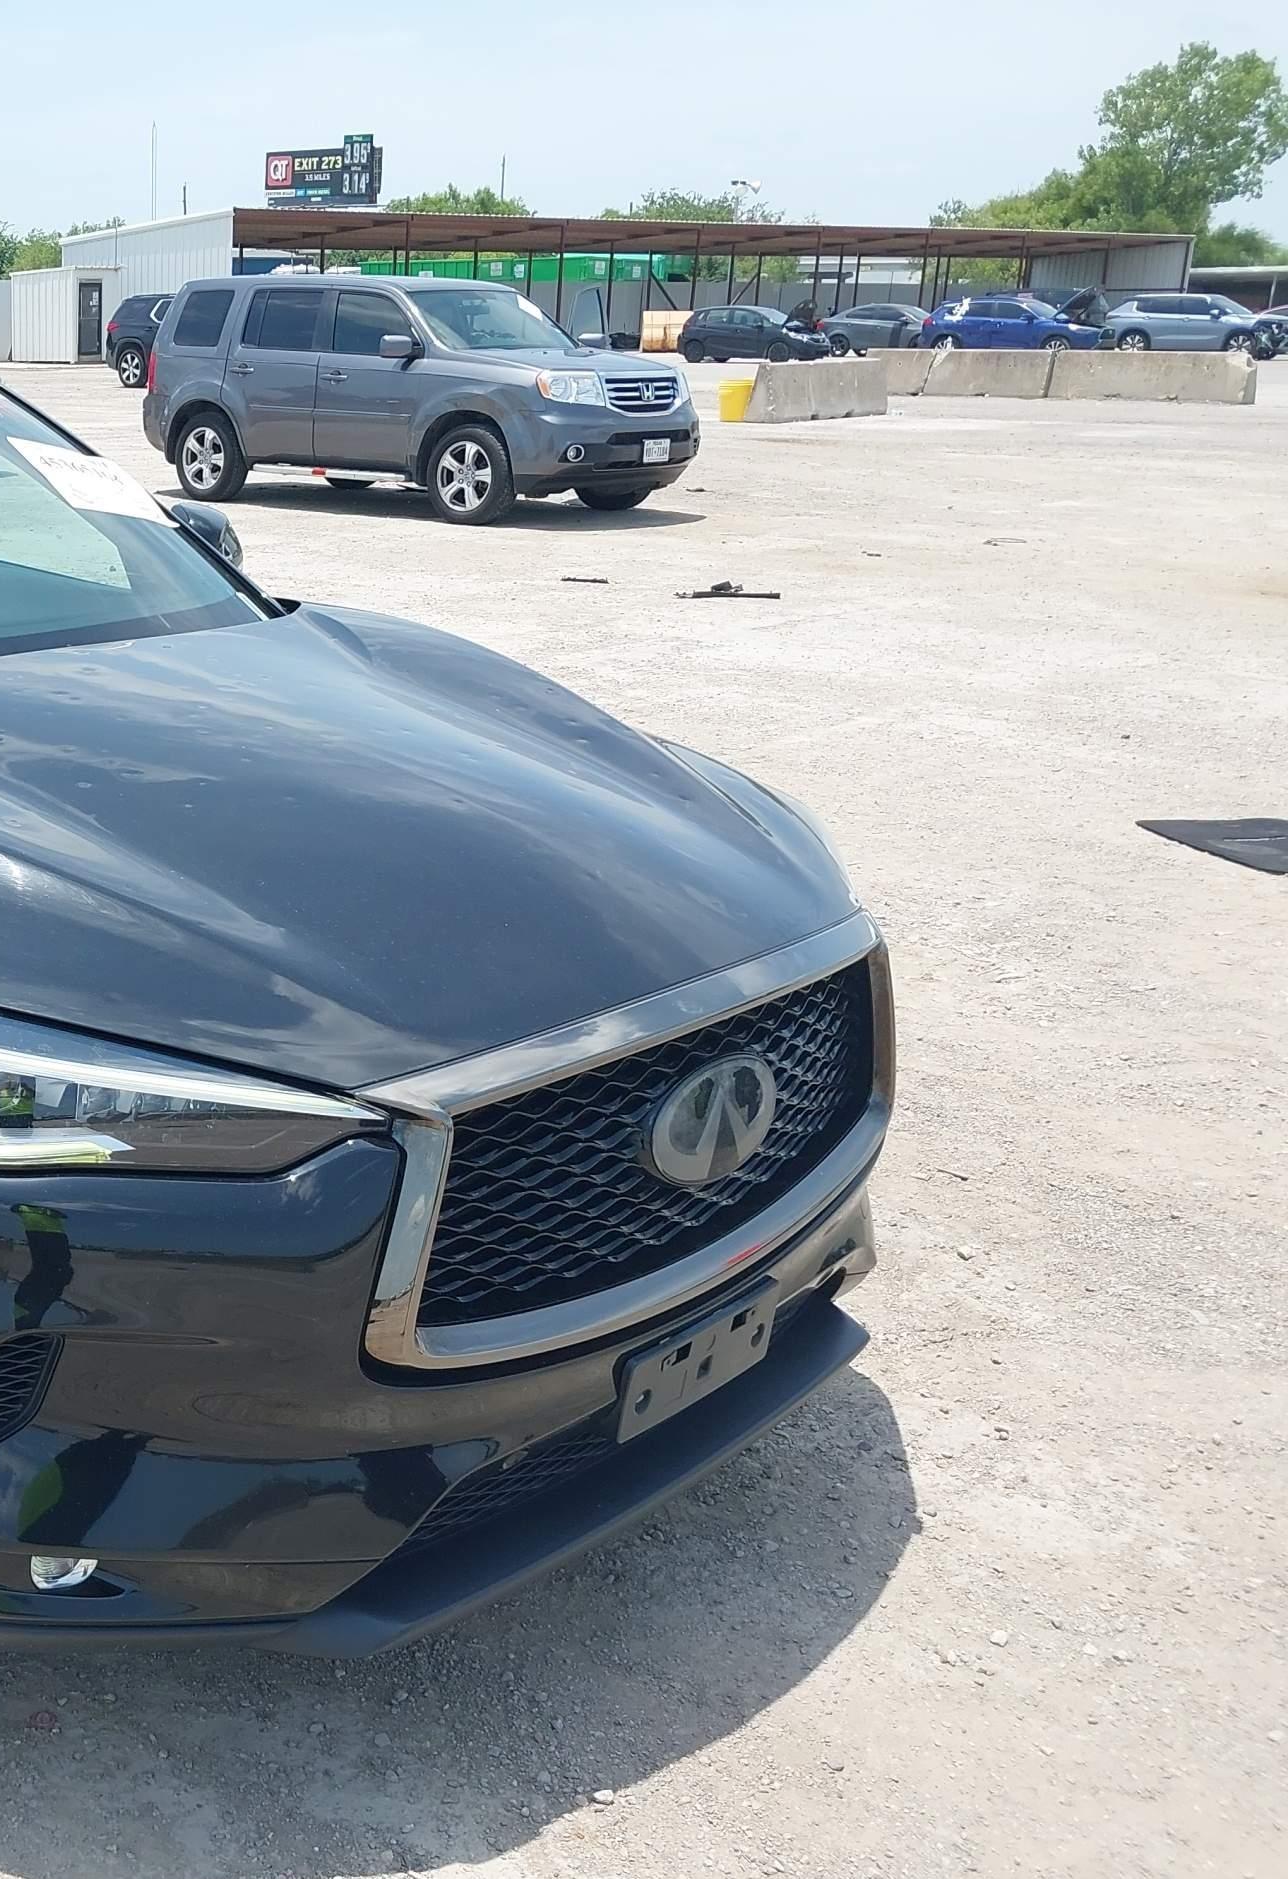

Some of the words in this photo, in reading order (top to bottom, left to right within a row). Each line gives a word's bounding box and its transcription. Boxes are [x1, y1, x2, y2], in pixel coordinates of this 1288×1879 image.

[270, 159, 288, 182] QT
[294, 157, 319, 171] EXIT
[321, 155, 342, 169] 273
[314, 173, 330, 181] MILES
